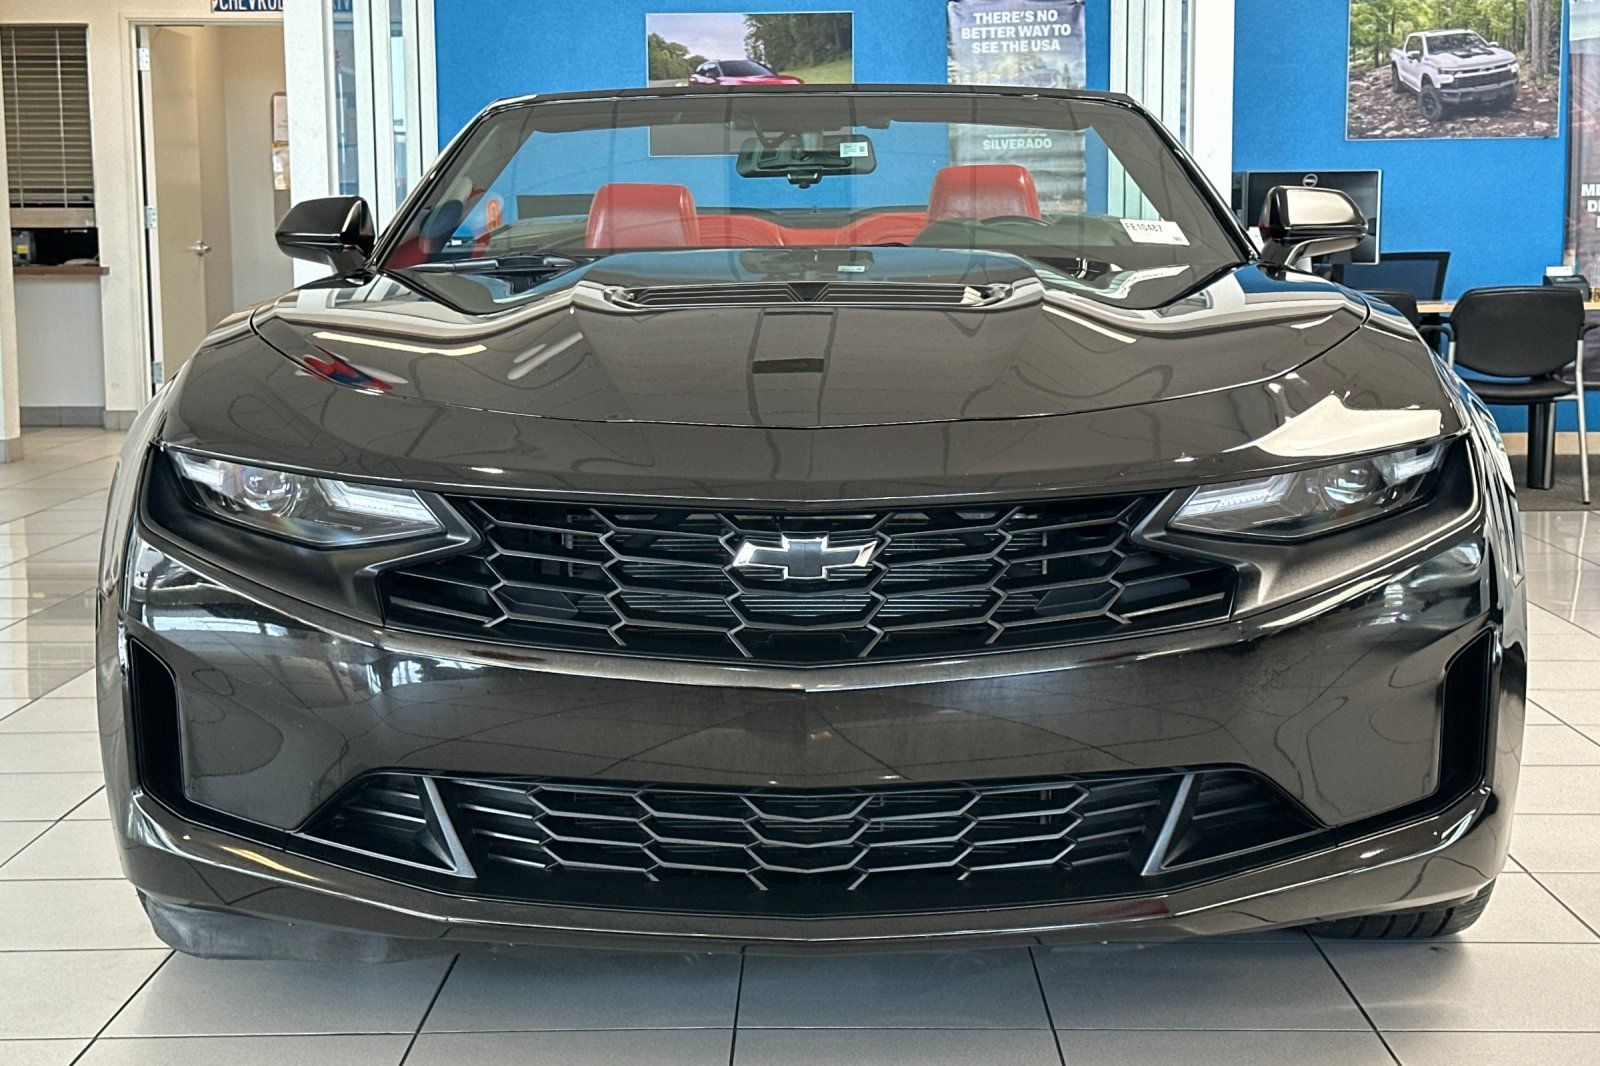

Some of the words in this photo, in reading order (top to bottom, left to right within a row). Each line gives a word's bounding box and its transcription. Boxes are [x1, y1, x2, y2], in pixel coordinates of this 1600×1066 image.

[974, 11, 1034, 24] THERE'S
[1037, 10, 1058, 22] NO
[962, 27, 1015, 40] BETTER
[1018, 25, 1051, 38] WAY
[1052, 24, 1071, 36] TO
[972, 41, 999, 54] SEE
[1000, 40, 1029, 53] THE
[1031, 38, 1061, 52] USA
[983, 138, 1052, 150] SILVERADO
